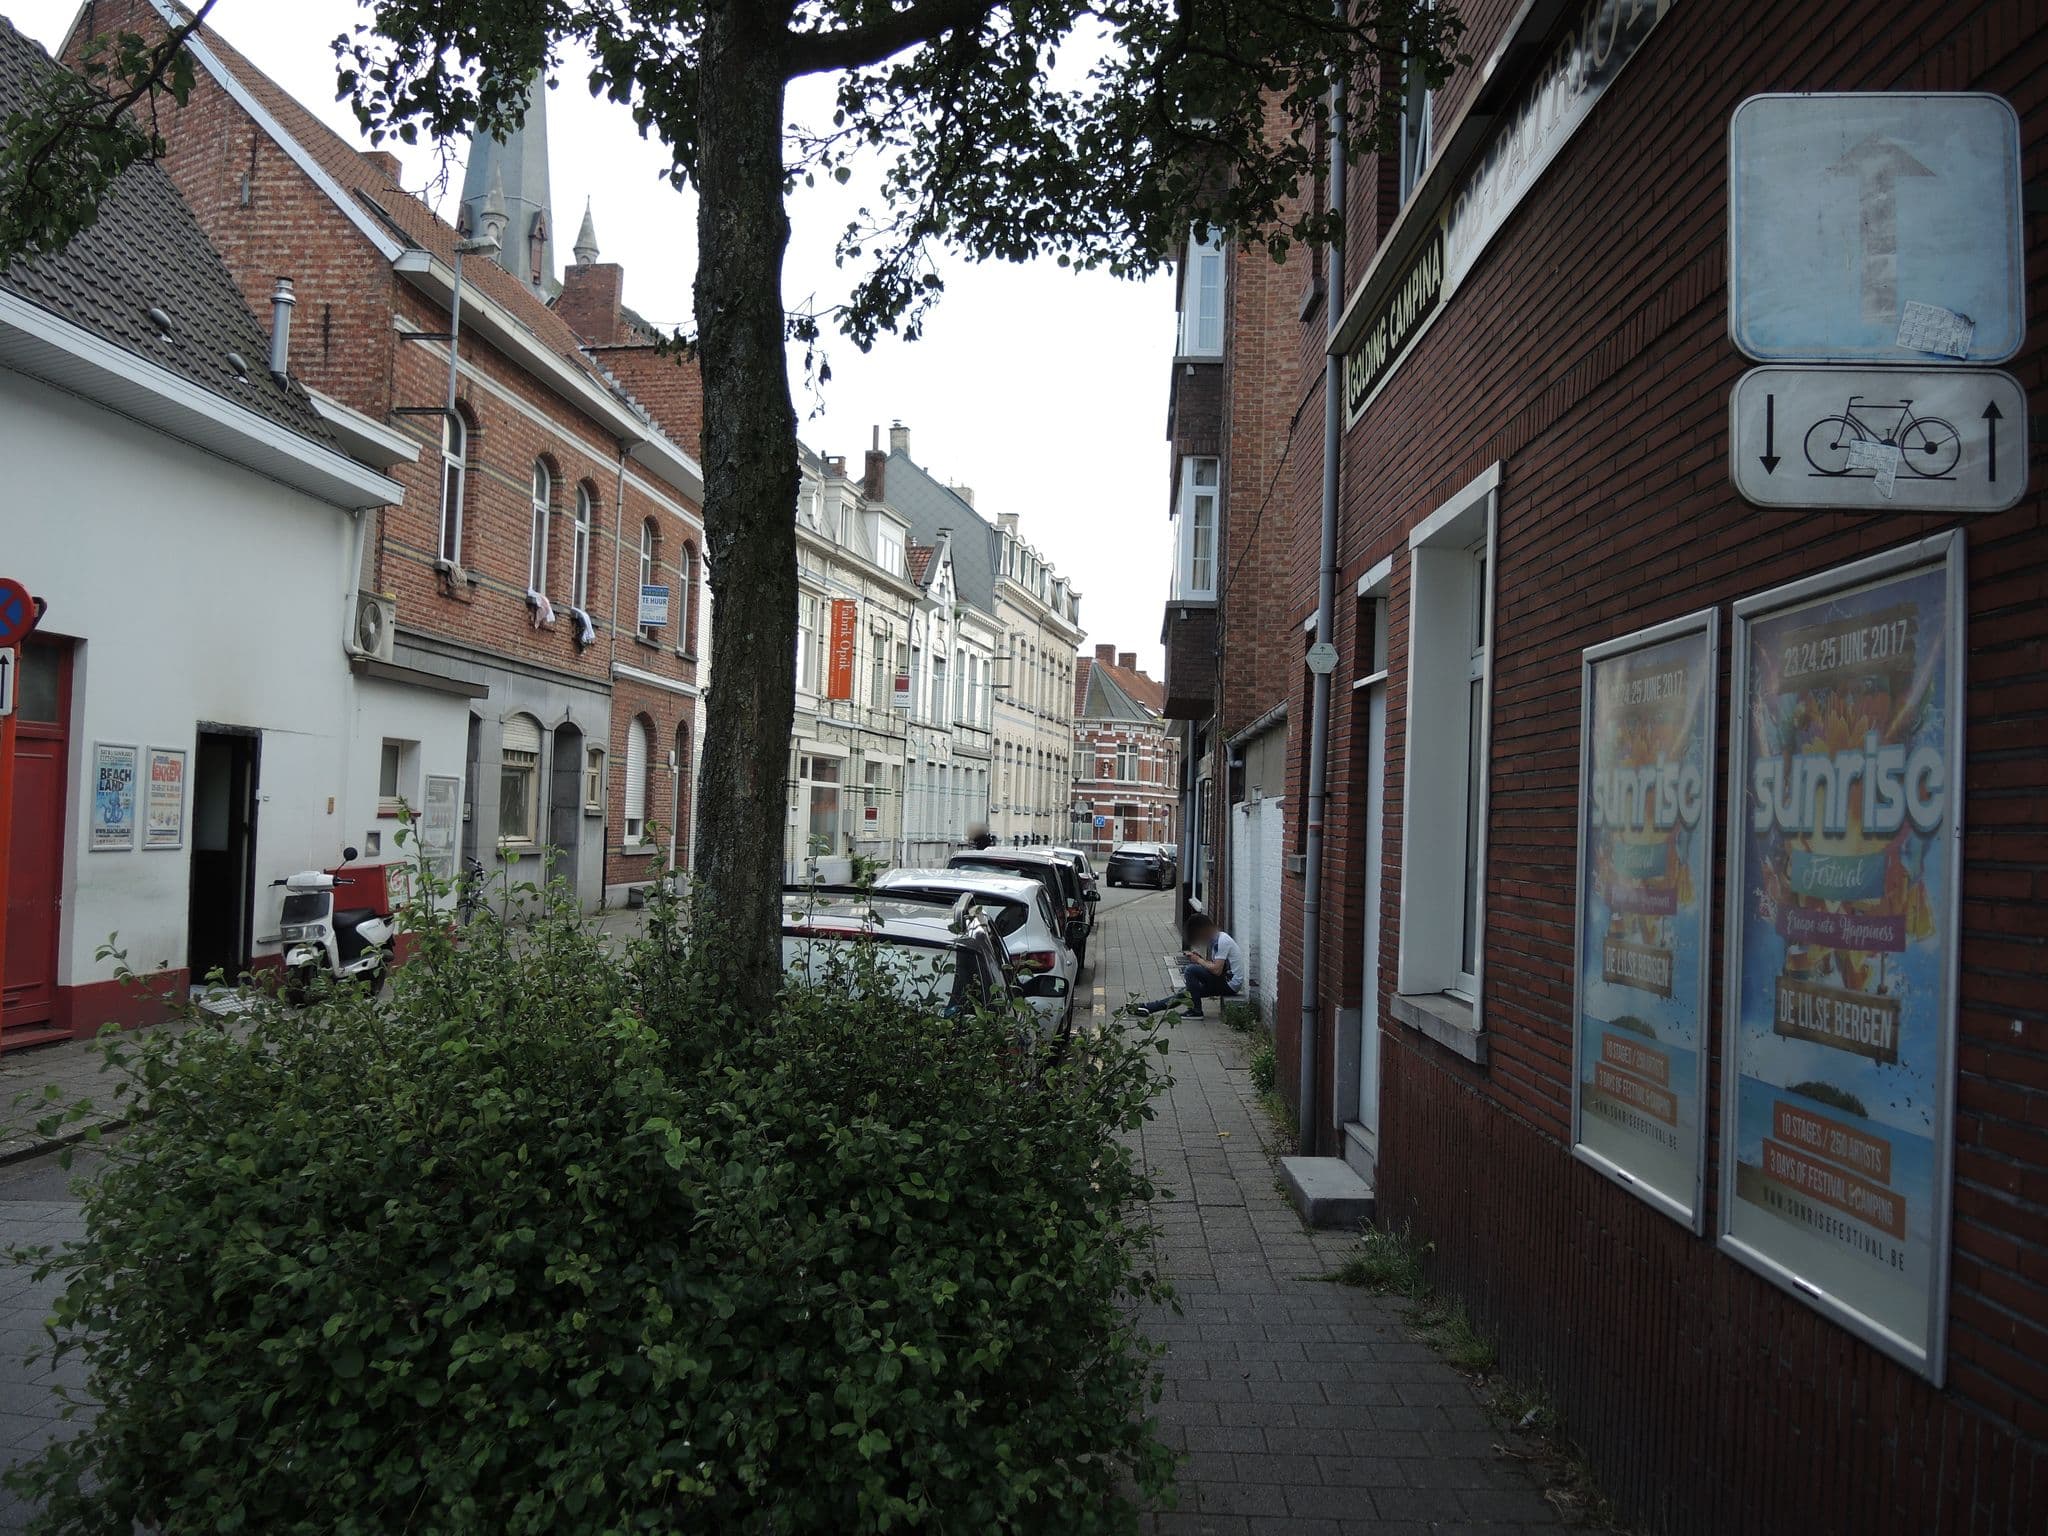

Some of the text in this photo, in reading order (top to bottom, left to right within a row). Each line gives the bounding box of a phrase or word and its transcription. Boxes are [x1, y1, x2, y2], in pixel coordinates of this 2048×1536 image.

[1350, 237, 1441, 405] GOLDING CAMPINA
[650, 597, 667, 606] HUUR
[836, 604, 853, 670] Fabrik Optik
[1838, 628, 1868, 667] JUNE
[1871, 618, 1908, 659] 2017
[1642, 675, 1663, 704] JUNE
[1663, 669, 1683, 698] 2017
[99, 779, 124, 792] LAND
[100, 767, 132, 782] BEACH
[1754, 728, 1944, 834] sunrise
[1803, 856, 1863, 890] Festival
[1839, 914, 1893, 945] Happiness
[1606, 946, 1615, 971] DE
[1779, 988, 1893, 1049] DE LILSE BERGEN
[1782, 1112, 1791, 1136] 10
[1791, 1115, 1823, 1148] STAGES
[1848, 1136, 1882, 1173] ARTISTS
[1776, 1152, 1796, 1183] DAYS
[1796, 1159, 1808, 1184] OF
[1807, 1165, 1847, 1204] FESTIVAL
